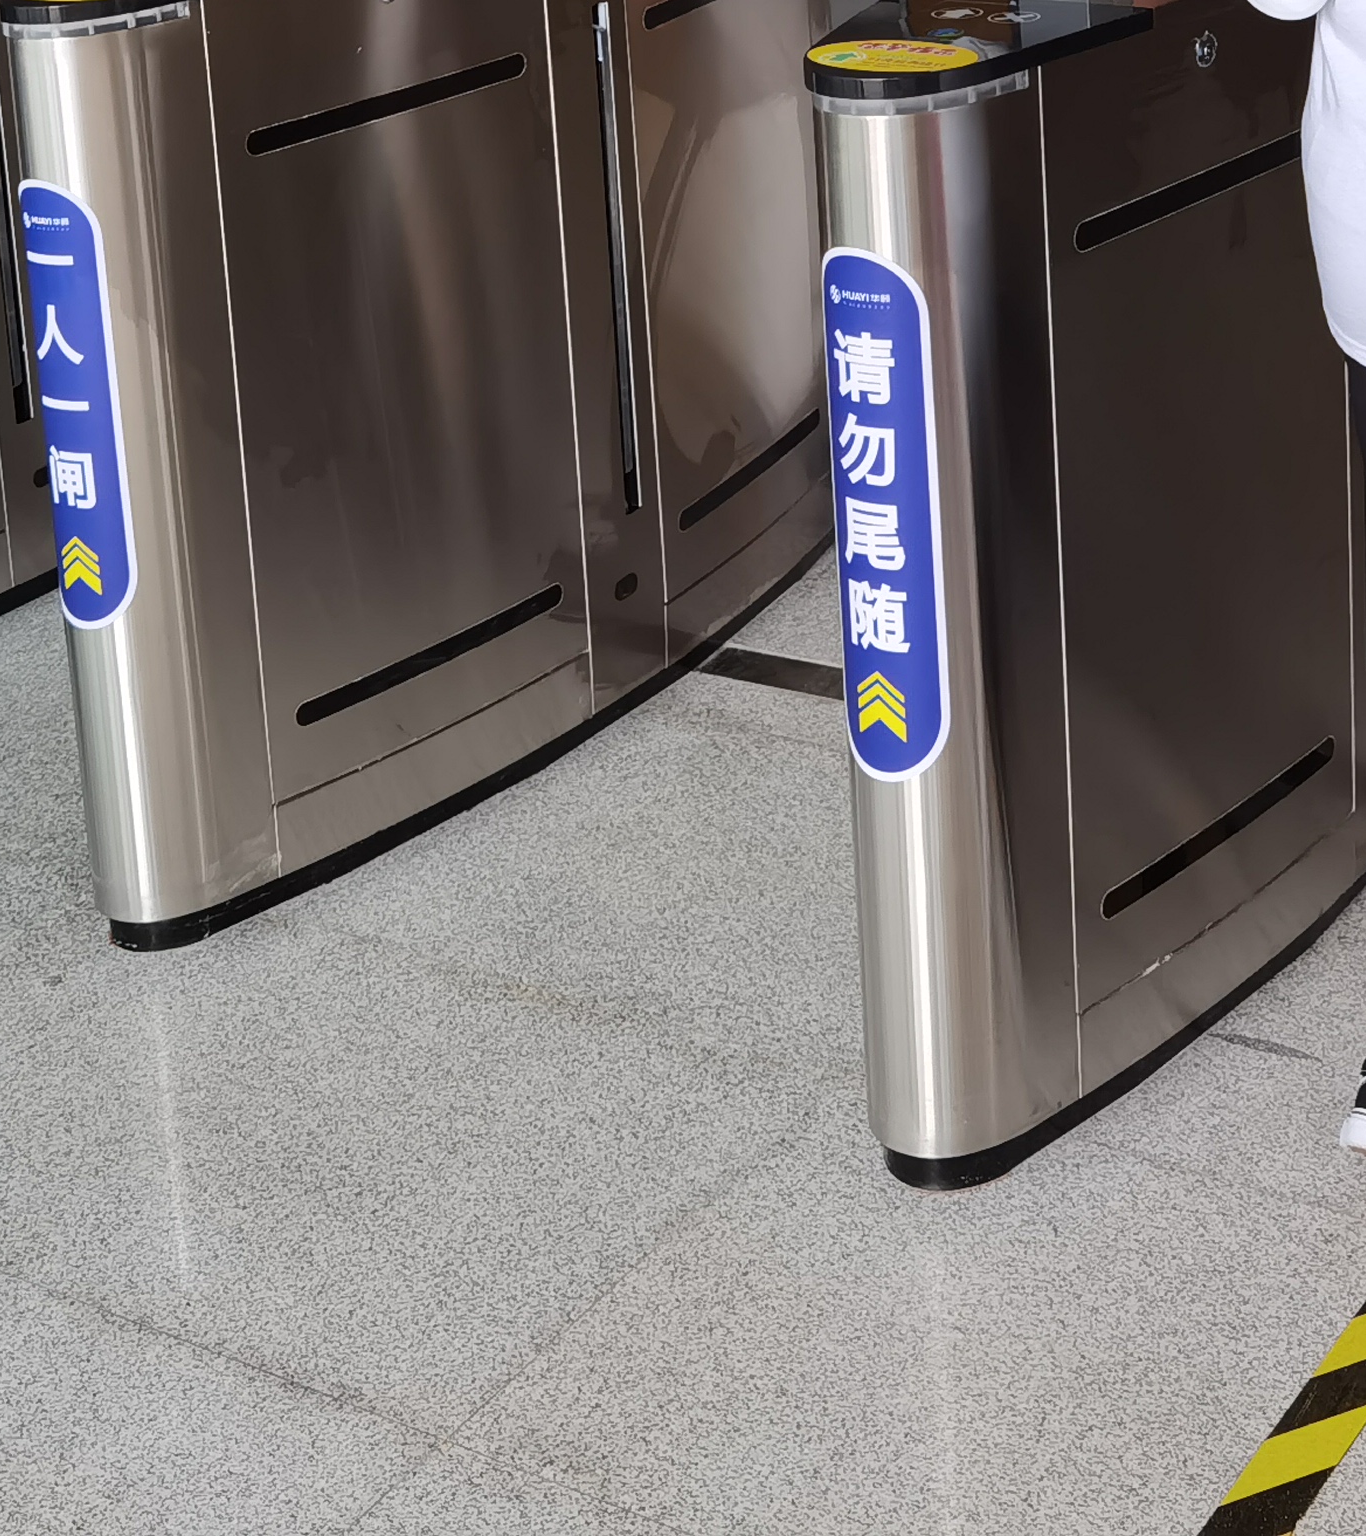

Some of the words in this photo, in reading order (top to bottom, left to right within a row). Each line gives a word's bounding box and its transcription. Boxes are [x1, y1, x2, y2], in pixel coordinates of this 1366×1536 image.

[26, 250, 97, 510] 一人一闸
[833, 329, 910, 654] 请勿尾随
